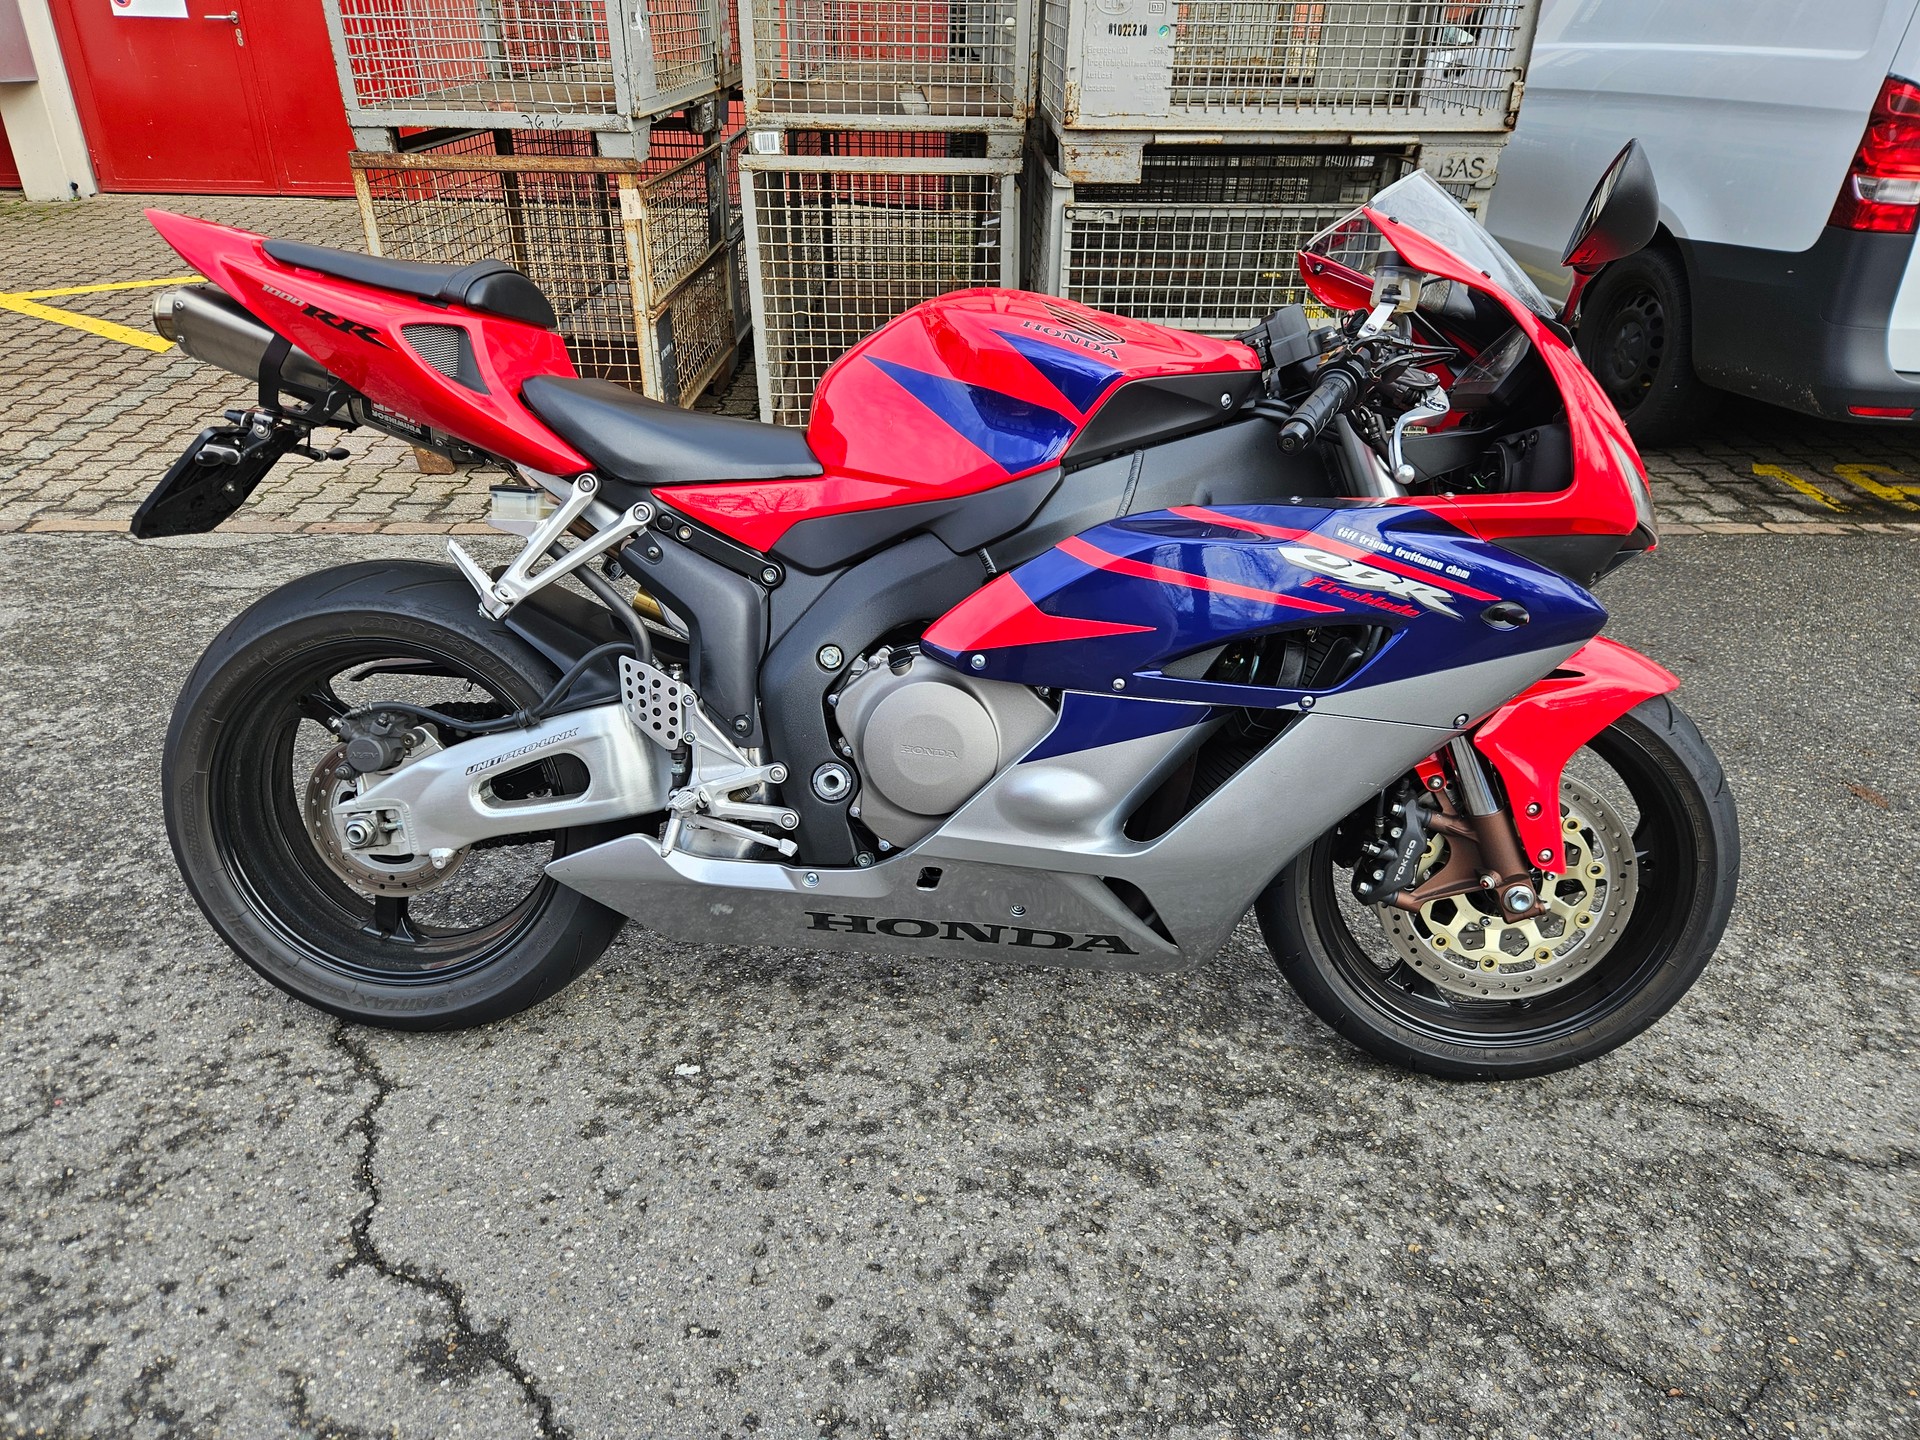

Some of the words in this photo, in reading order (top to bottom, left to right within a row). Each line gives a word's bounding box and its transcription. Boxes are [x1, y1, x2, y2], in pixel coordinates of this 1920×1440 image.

[1438, 157, 1484, 178] BAS
[262, 284, 305, 307] 1000
[301, 302, 396, 352] RR
[1022, 320, 1120, 361] HONDA
[371, 409, 422, 434] YOSHIMURA
[1337, 526, 1356, 542] töff
[1358, 533, 1394, 554] träume
[1394, 546, 1444, 571] truttmann
[1445, 564, 1471, 580] cham
[1277, 547, 1466, 623] CBR
[1301, 575, 1421, 618] Fireblade
[361, 614, 524, 689] BRIDGESTONE
[465, 755, 502, 776] UNIT
[900, 744, 959, 760] HONDA
[1393, 839, 1417, 882] TOKICO
[804, 911, 1140, 955] HONDA
